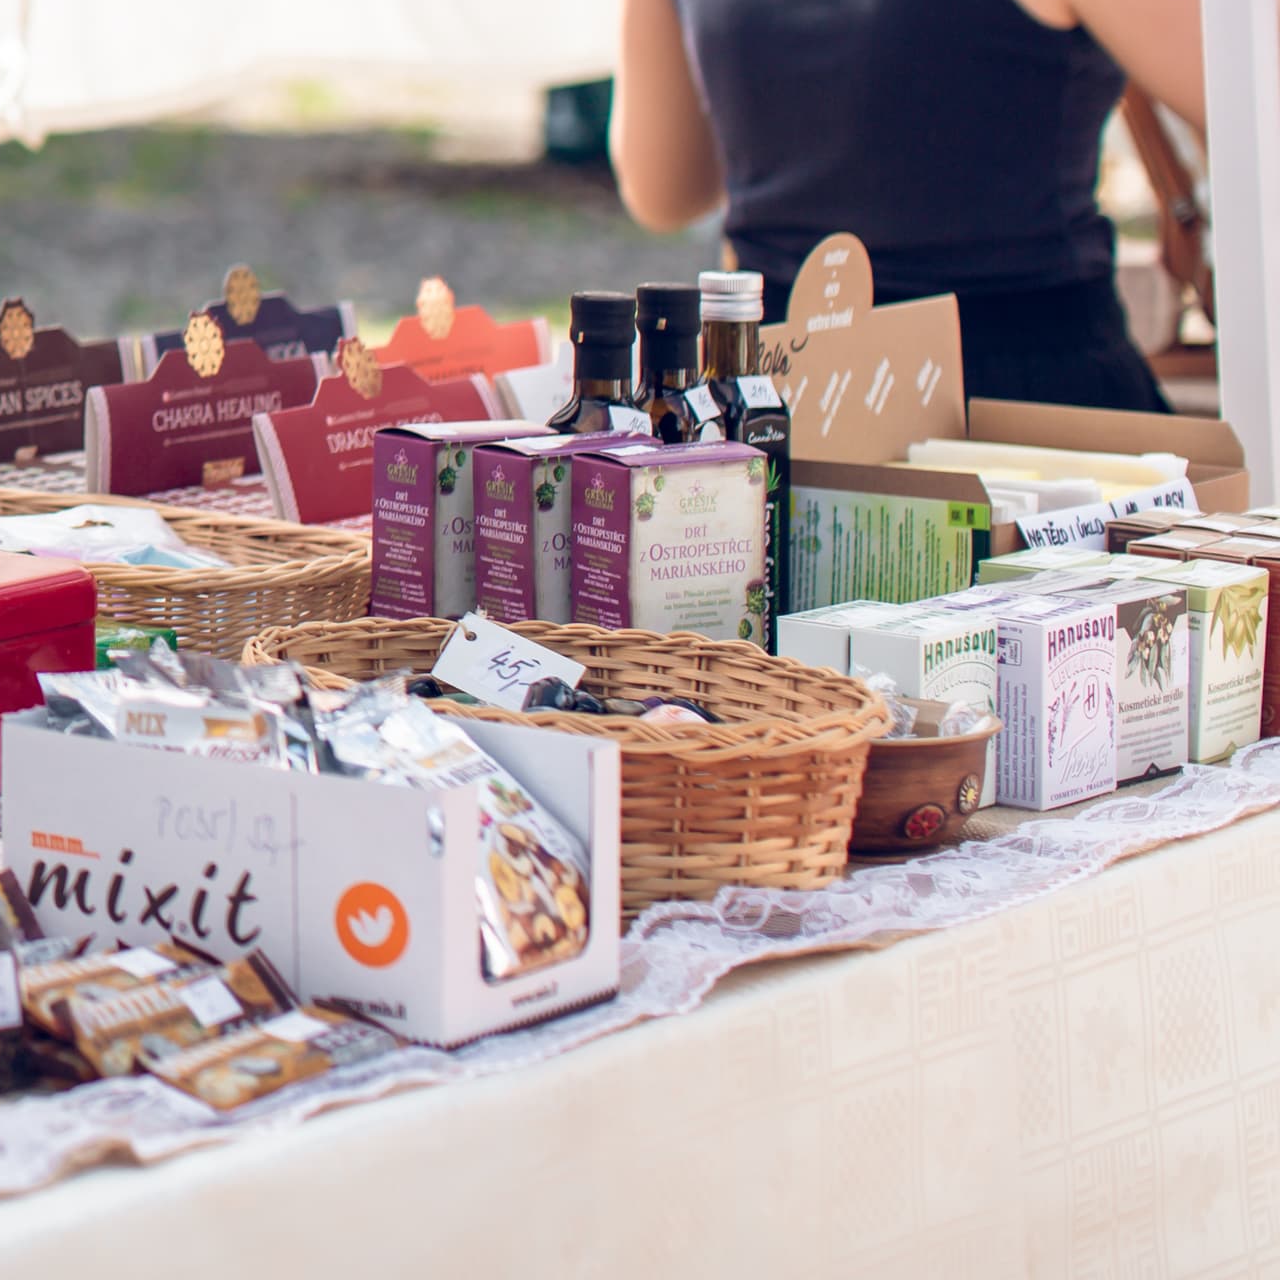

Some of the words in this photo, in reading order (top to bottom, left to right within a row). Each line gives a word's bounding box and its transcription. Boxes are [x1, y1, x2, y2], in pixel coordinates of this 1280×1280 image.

[25, 380, 83, 412] SPICES
[152, 403, 213, 432] CHAKRA
[216, 391, 282, 422] HEALING
[124, 711, 167, 738] MIX
